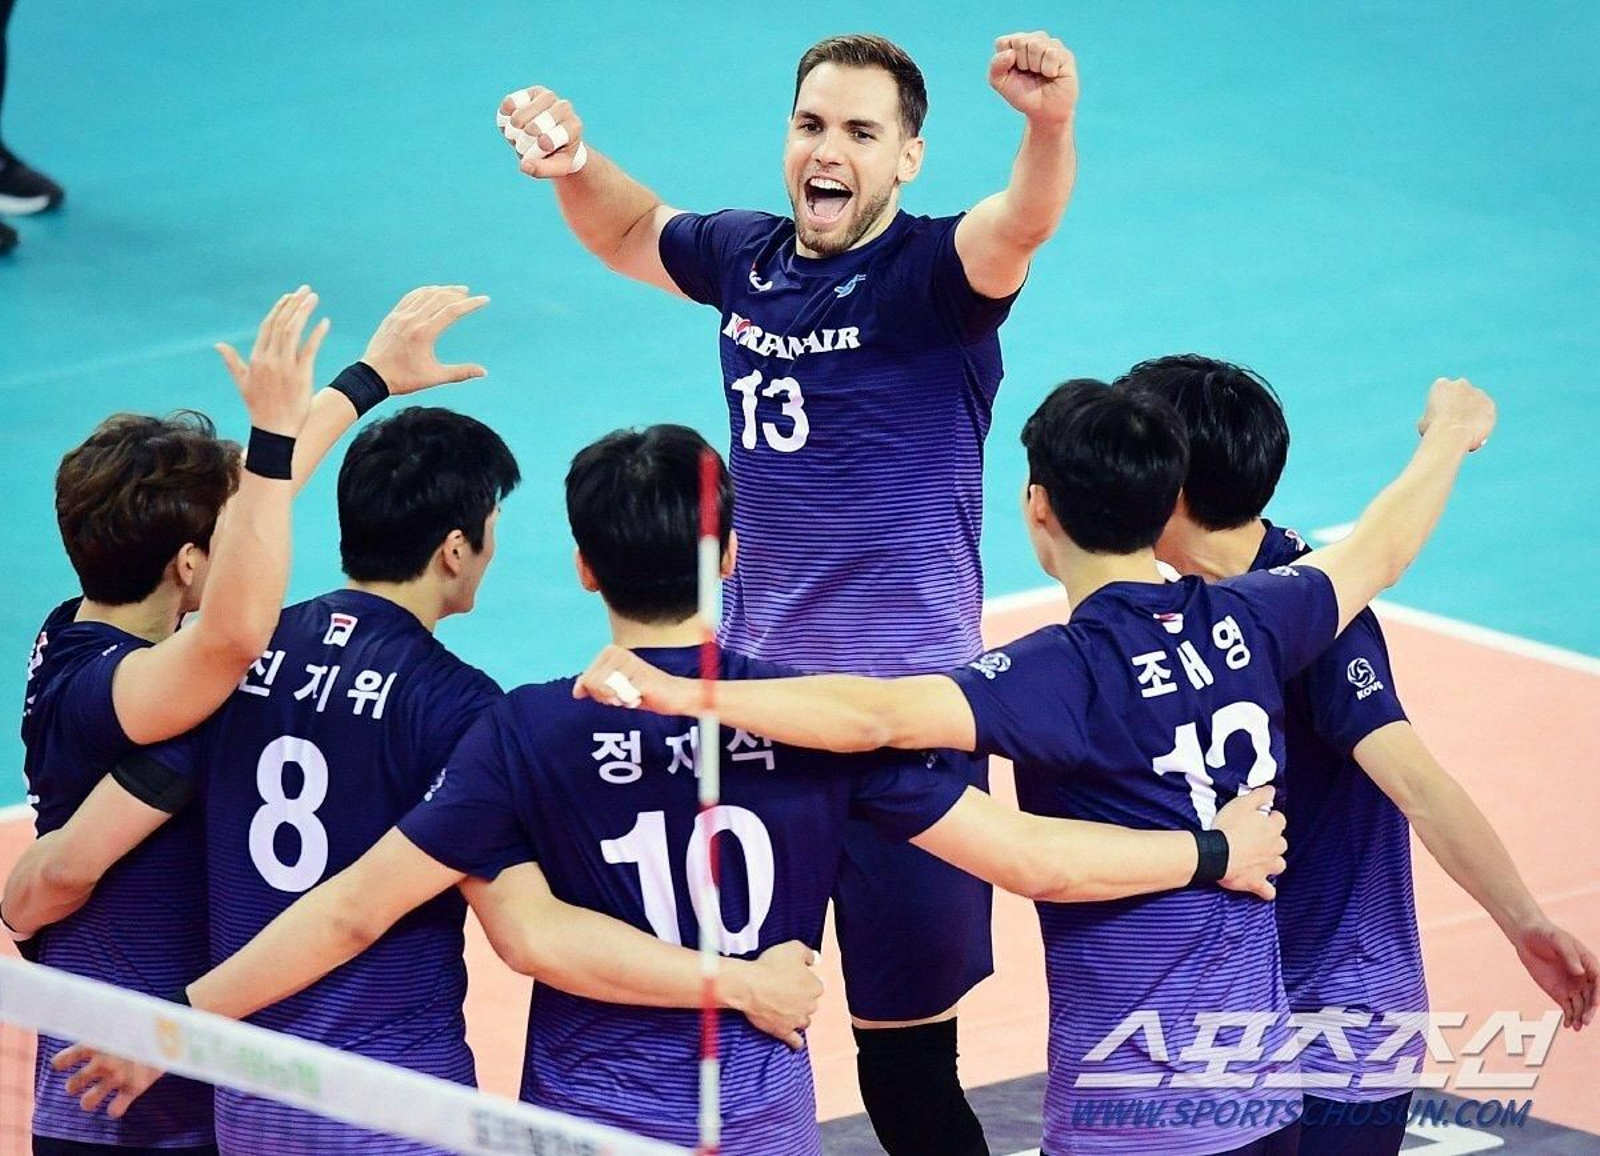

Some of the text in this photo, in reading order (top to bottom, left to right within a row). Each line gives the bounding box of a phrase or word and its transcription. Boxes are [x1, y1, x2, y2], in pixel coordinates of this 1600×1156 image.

[731, 368, 810, 453] 13
[249, 735, 329, 892] 8
[600, 805, 775, 956] 10
